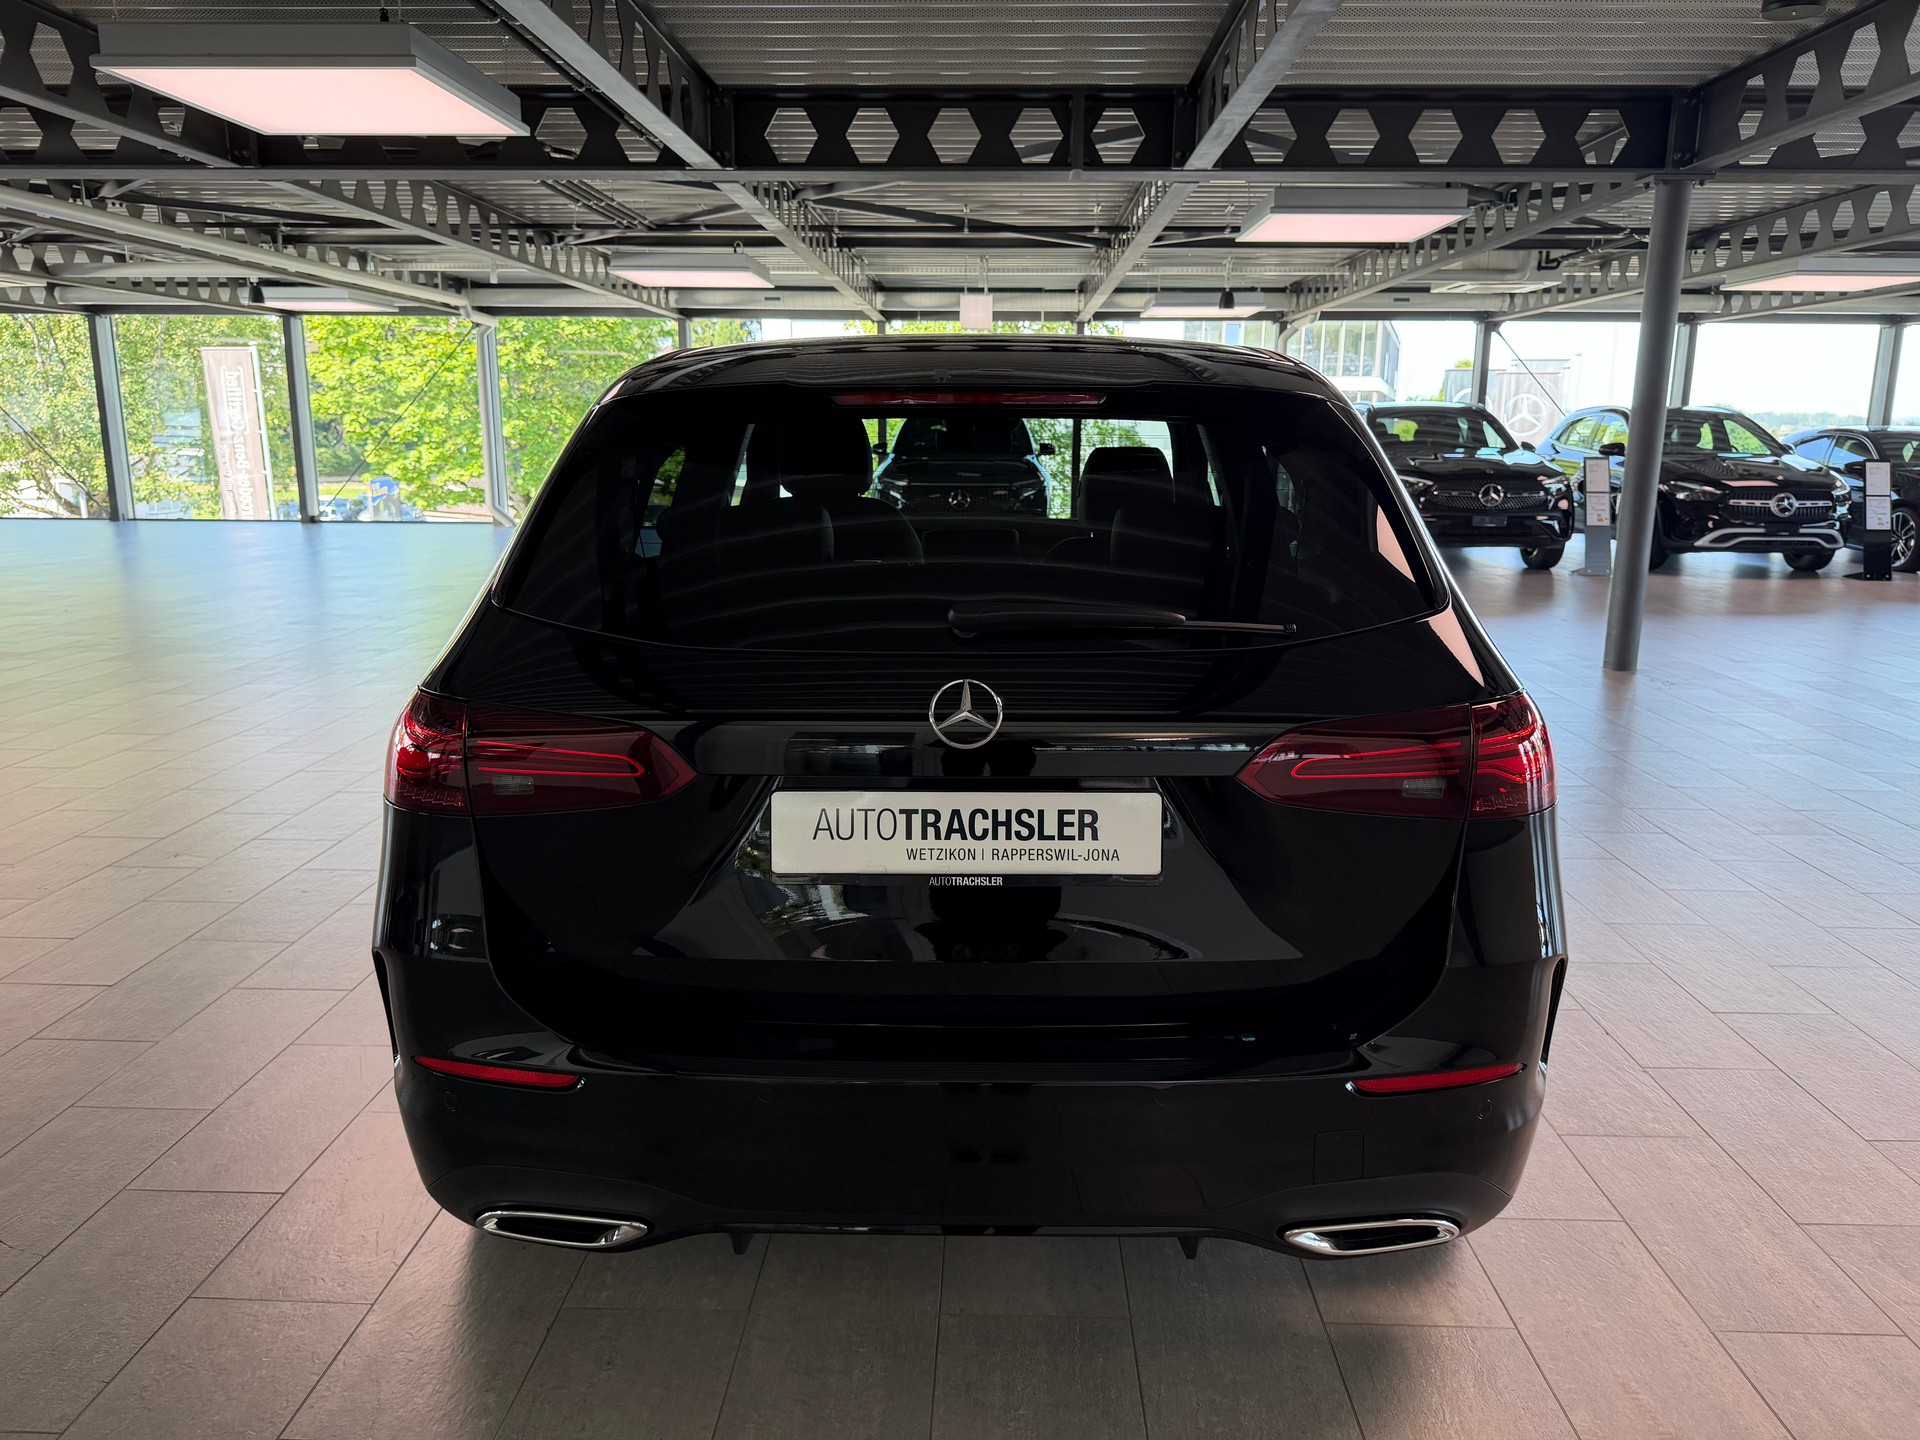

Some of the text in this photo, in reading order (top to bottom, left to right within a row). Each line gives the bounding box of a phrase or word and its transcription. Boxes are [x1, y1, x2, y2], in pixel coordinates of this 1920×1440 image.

[812, 808, 1099, 842] AUTOTRACHSLER
[906, 847, 976, 862] WETZIKON
[991, 847, 1120, 863] RAPPERSWIL-JONA
[929, 876, 1003, 886] AUTOTRACHSLER
